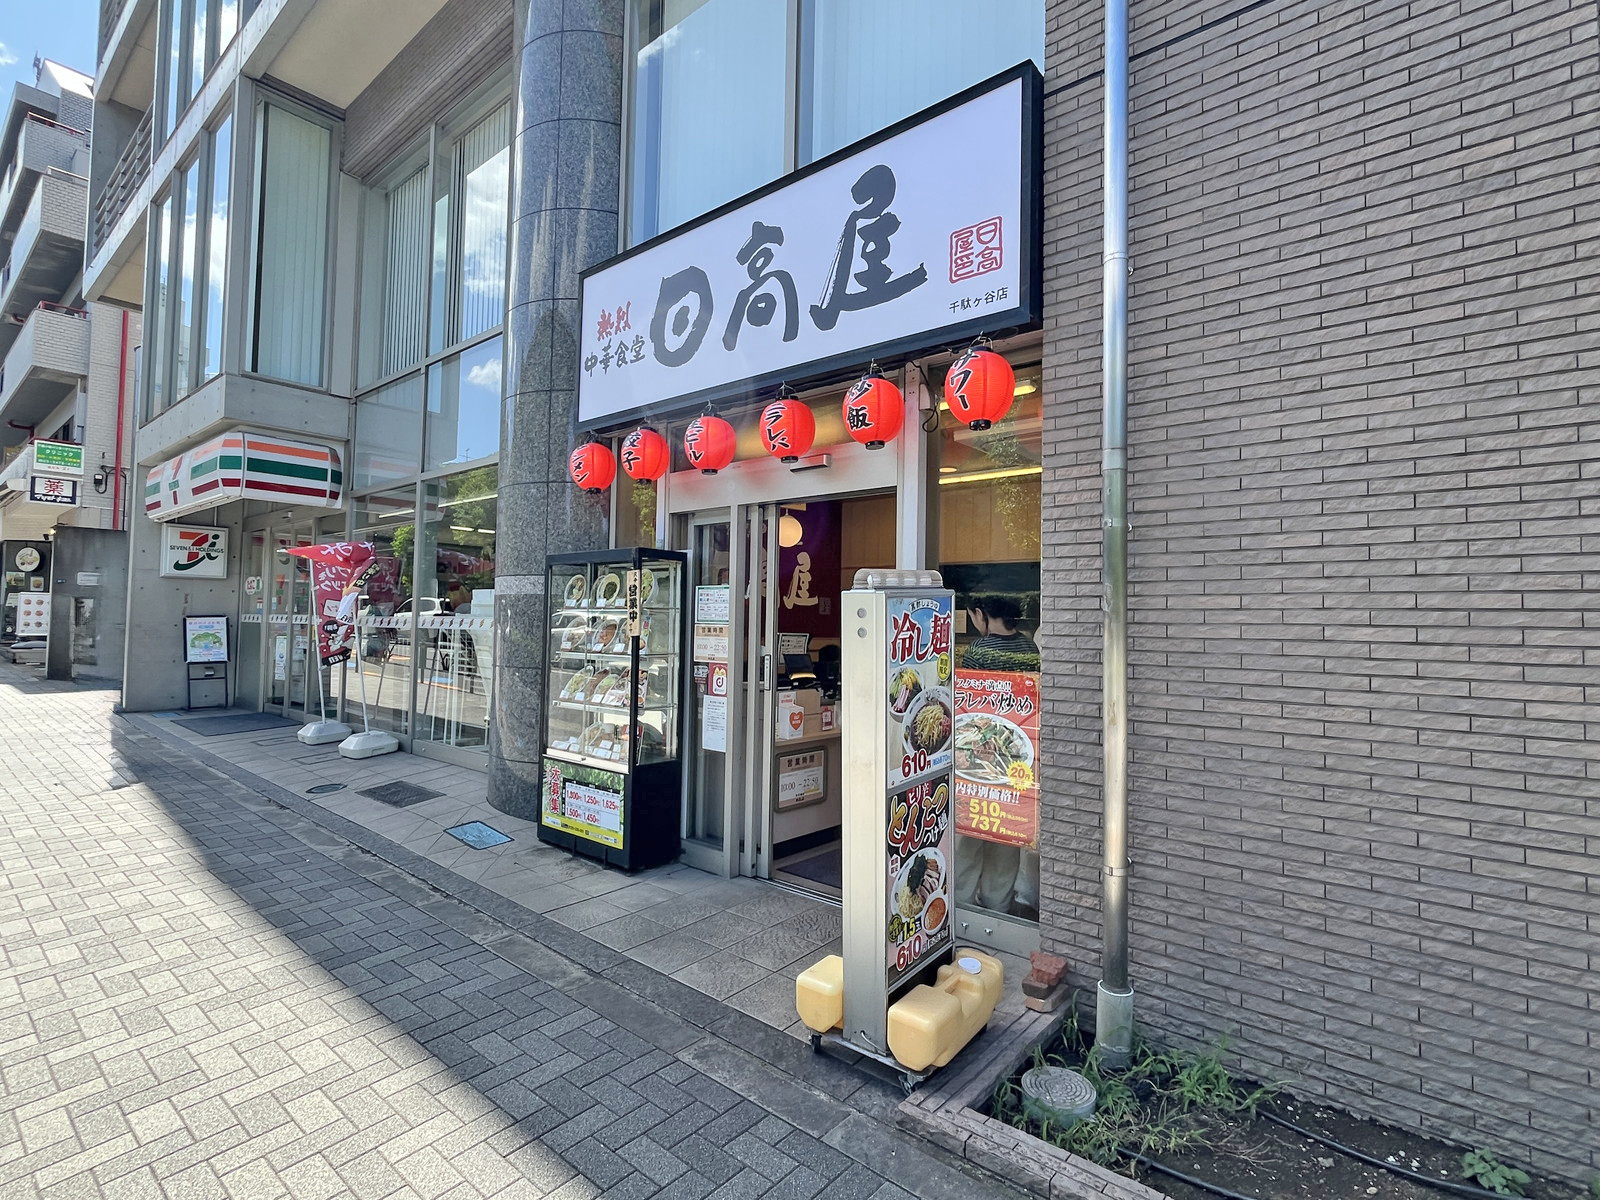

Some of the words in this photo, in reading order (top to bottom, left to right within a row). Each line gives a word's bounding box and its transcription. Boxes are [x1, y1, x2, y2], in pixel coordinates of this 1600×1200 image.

[649, 164, 928, 367] 日高屋
[584, 334, 645, 377] 中華食堂
[950, 350, 980, 411] サワー
[845, 380, 875, 431] 炒飯
[44, 479, 64, 495] 薬
[891, 611, 951, 664] 冷し麺
[955, 691, 1033, 715] ラレバ炒め
[902, 749, 931, 778] 610円
[955, 782, 1020, 803] 内特別価格!!
[969, 798, 1006, 818] 510円
[888, 783, 949, 857] とんこつ
[969, 814, 1006, 834] 737円
